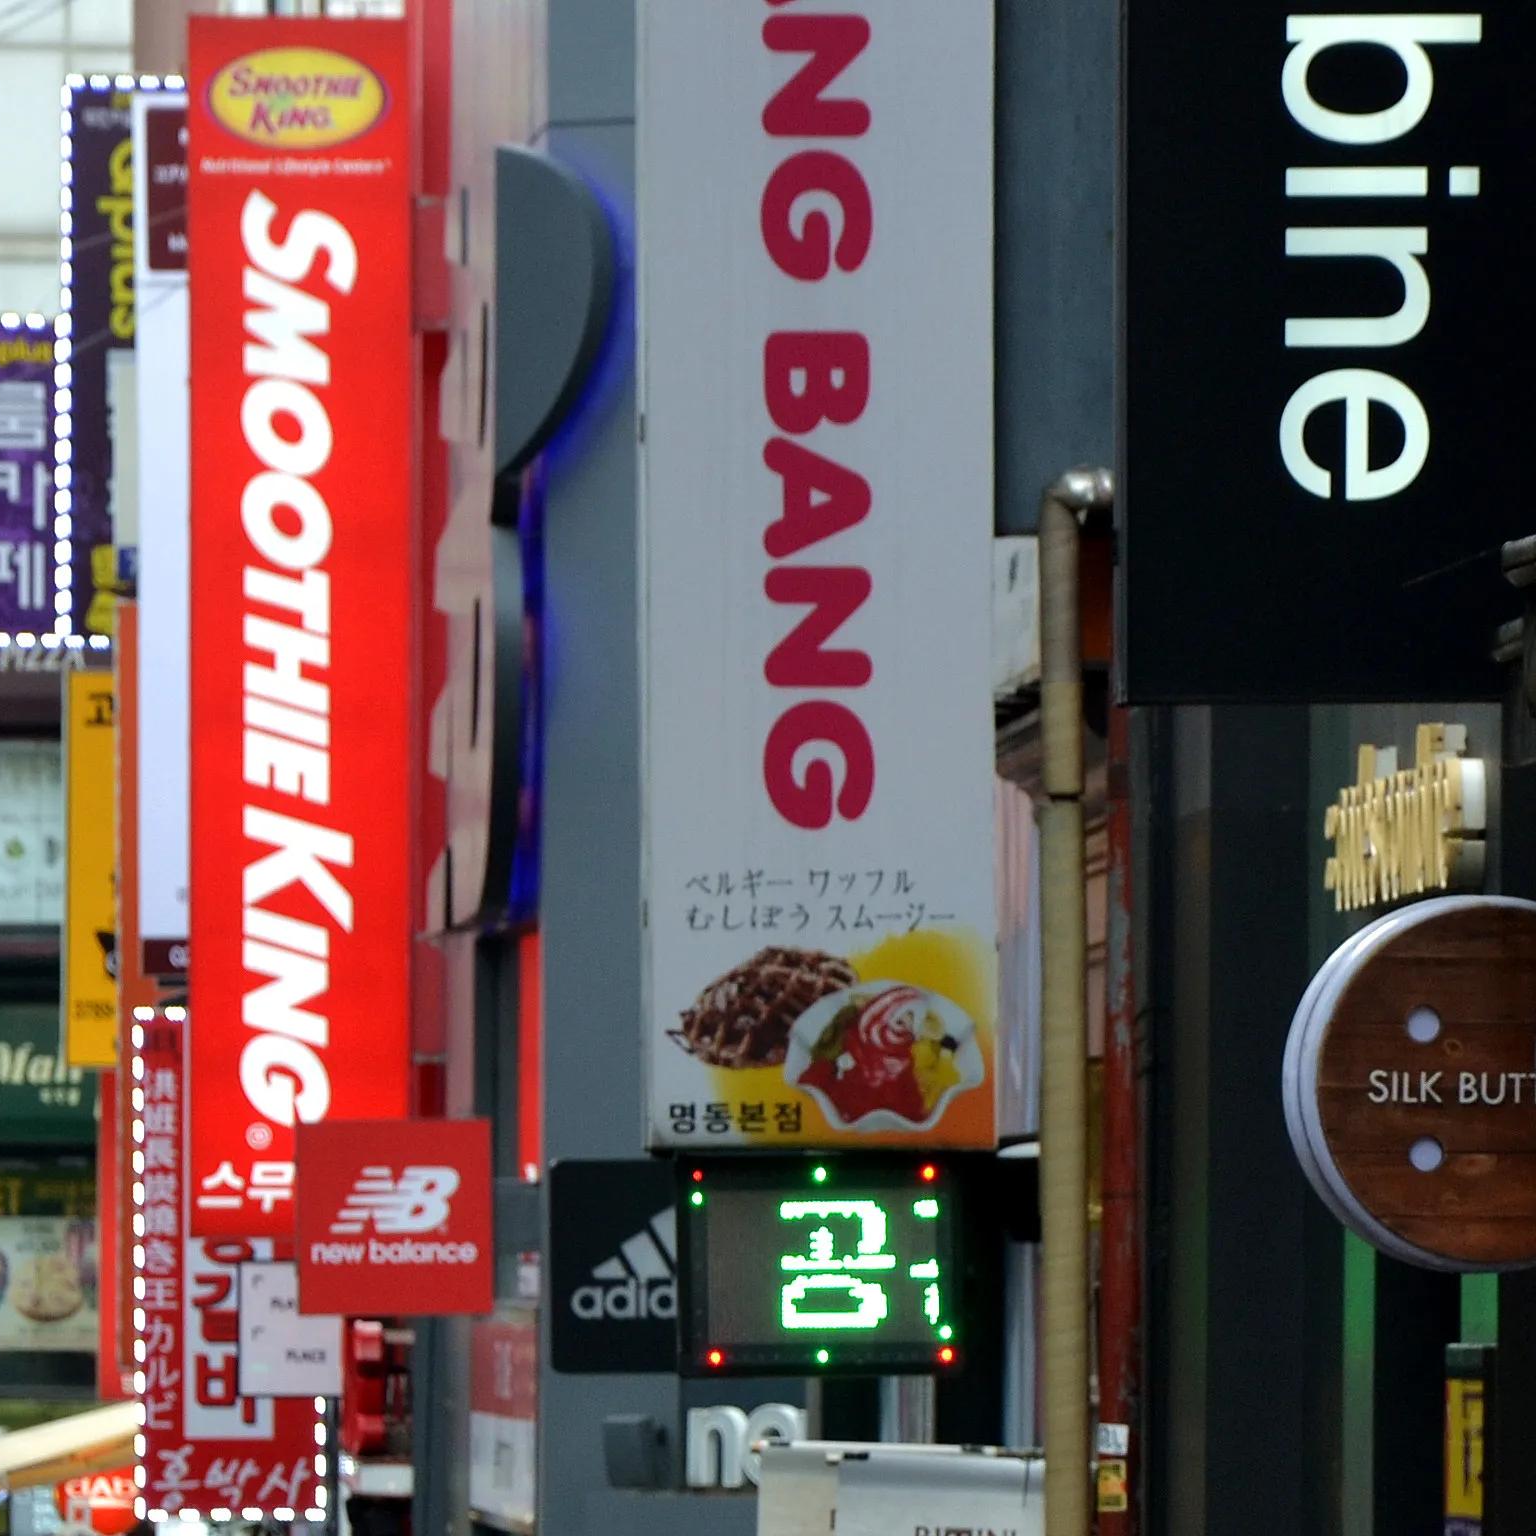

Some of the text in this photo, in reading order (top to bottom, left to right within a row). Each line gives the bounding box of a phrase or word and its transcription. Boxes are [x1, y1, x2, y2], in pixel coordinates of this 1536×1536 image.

[229, 66, 364, 100] SMOOTHIE
[249, 100, 334, 134] KING
[1279, 12, 1482, 501] bine
[761, 0, 875, 830] NG BANG
[239, 190, 357, 1127] SMOOTHIE KING
[809, 869, 916, 897] ワッフル
[1368, 1071, 1442, 1105] SILK
[669, 1102, 804, 1134] 명동본점
[310, 1237, 478, 1266] new balance
